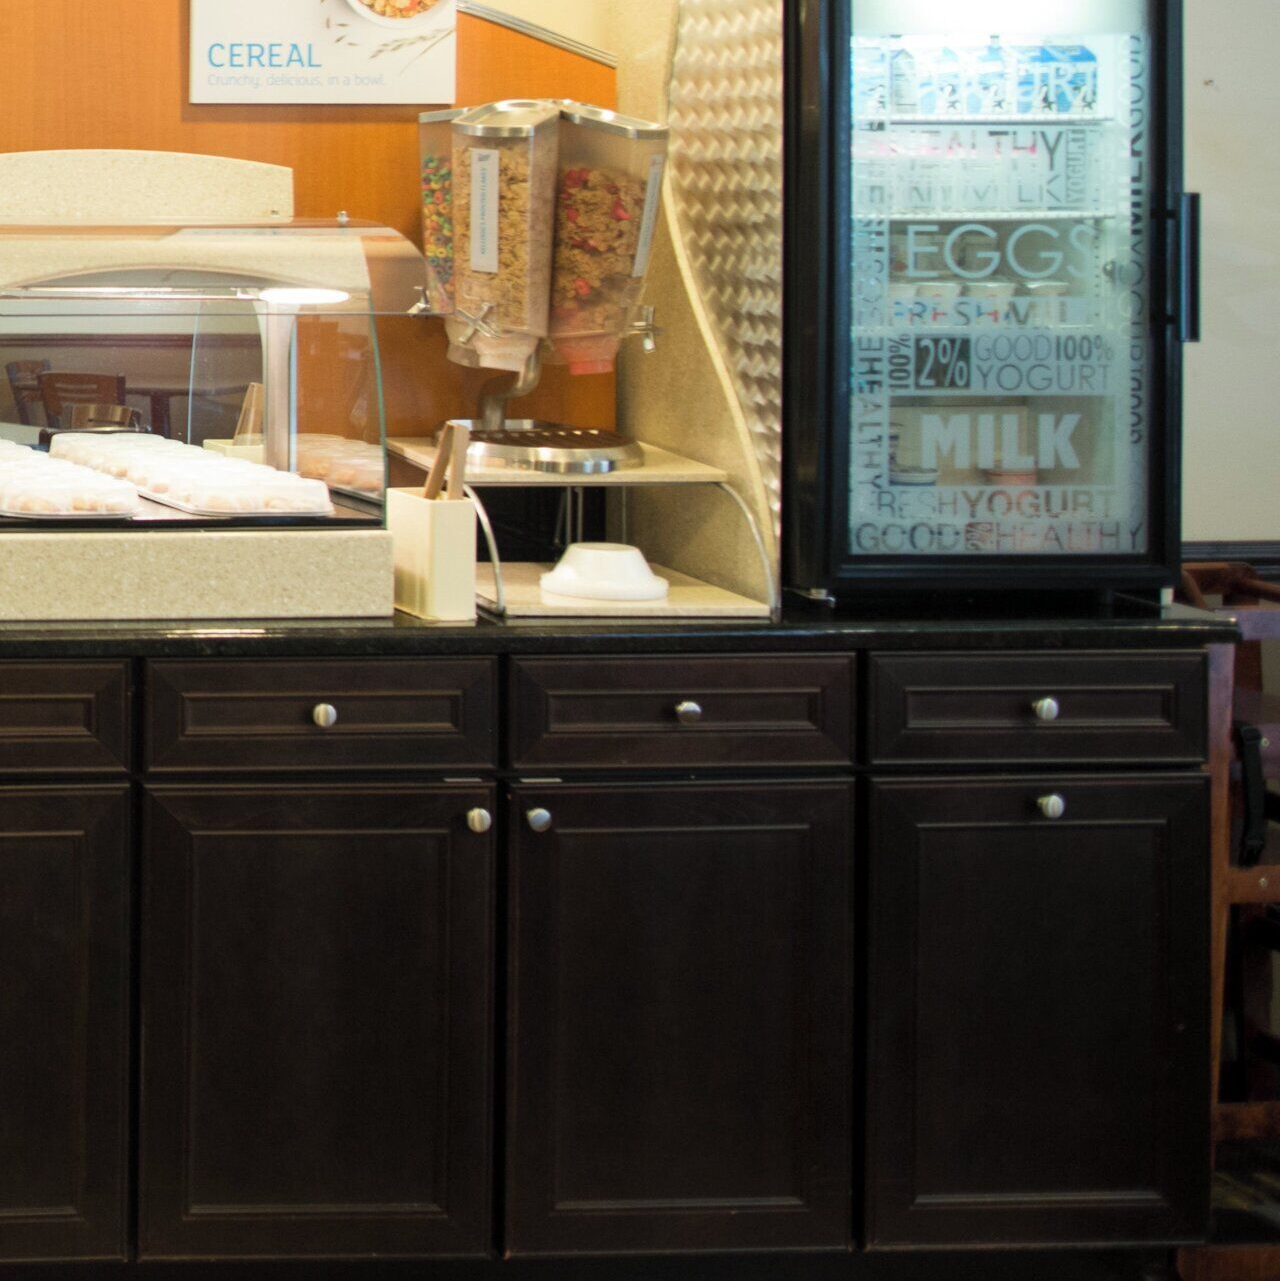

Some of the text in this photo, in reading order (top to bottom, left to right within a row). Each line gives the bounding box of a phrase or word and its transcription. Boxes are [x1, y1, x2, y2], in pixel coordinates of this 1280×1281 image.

[208, 43, 322, 68] CEREAL
[207, 73, 264, 89] Crunchy,
[266, 73, 324, 88] delicious,
[327, 74, 340, 86] in
[343, 76, 351, 86] a
[1117, 131, 1144, 236] MILK
[907, 223, 1096, 279] EGGS
[887, 333, 912, 390] 100%
[917, 338, 969, 387] 2%
[974, 334, 1114, 362] GOOD 100%
[975, 363, 1112, 391] YOGURT
[857, 357, 885, 491] HEALTHY
[920, 413, 1082, 469] MILK
[960, 490, 1117, 519] YOGURT
[855, 521, 961, 552] GOOD
[994, 521, 1144, 551] HEALTHY
